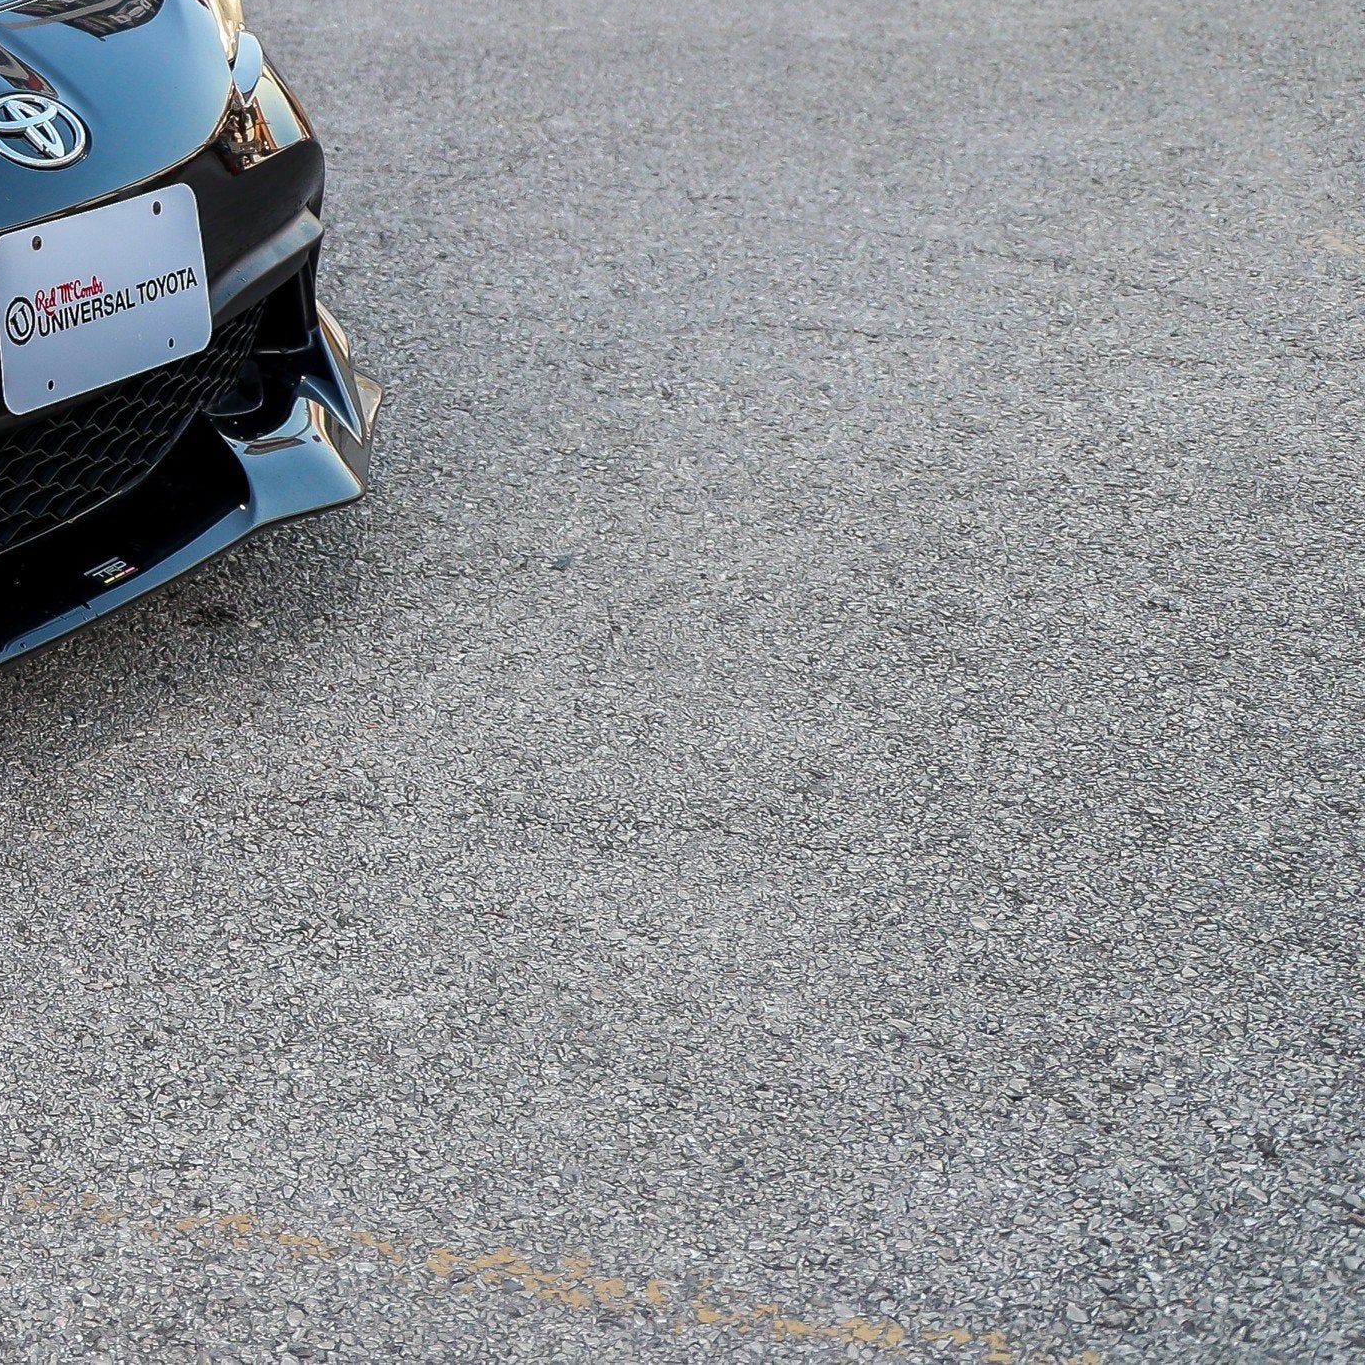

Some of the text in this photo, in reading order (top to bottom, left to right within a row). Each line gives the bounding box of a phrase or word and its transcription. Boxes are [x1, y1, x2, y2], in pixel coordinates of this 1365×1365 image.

[35, 288, 57, 317] Red
[58, 275, 105, 305] McCombs
[38, 267, 199, 337] UNIVERSAL TOYOTA
